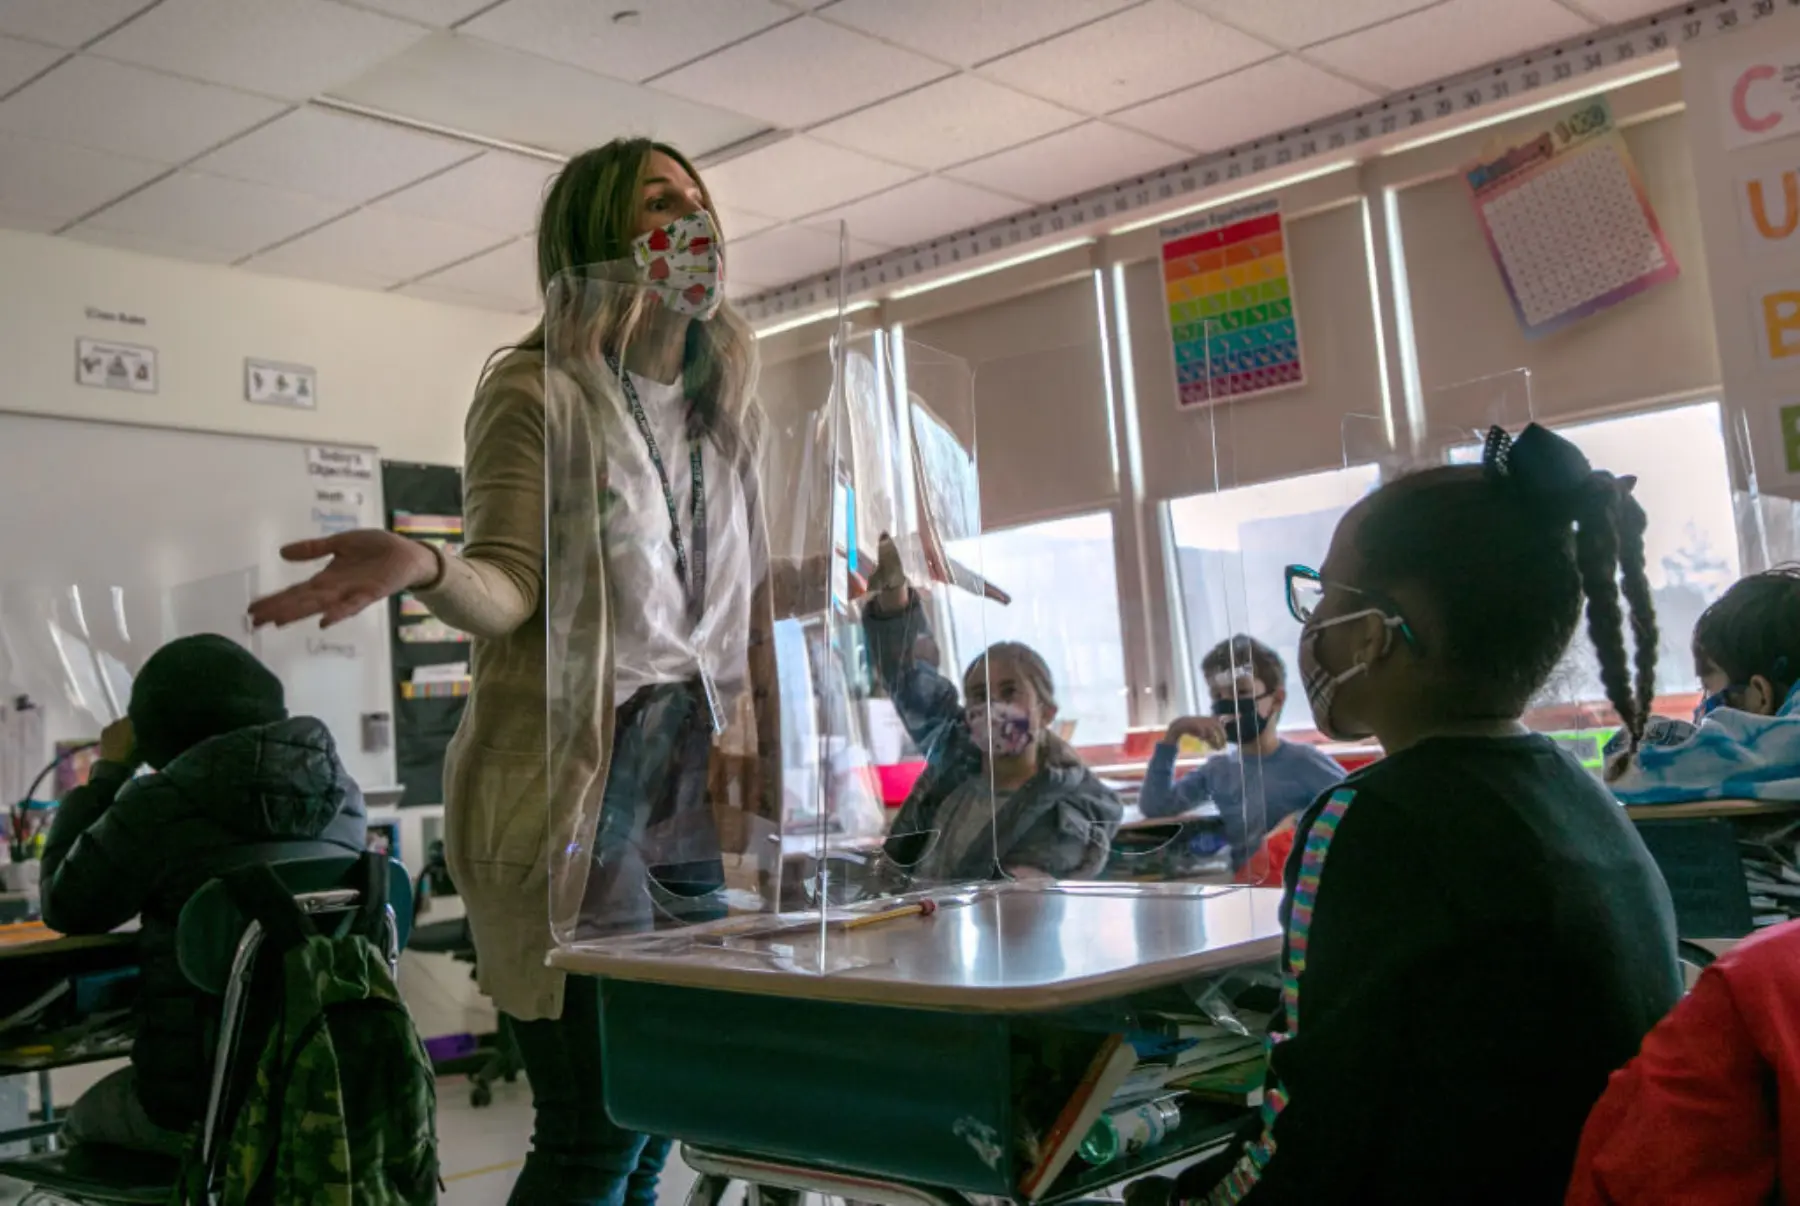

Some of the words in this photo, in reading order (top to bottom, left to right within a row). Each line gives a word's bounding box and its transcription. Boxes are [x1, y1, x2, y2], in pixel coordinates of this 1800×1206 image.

[1462, 90, 1481, 107] 30
[1492, 80, 1509, 98] 31
[1521, 71, 1541, 89] 32
[1552, 61, 1572, 80] 33
[1582, 52, 1603, 71] 34
[1616, 42, 1635, 61] 35
[1647, 32, 1668, 51] 36
[1682, 20, 1702, 40] 37
[1716, 9, 1738, 31] 38
[1752, 0, 1775, 19] 39
[1730, 65, 1783, 132] C
[1747, 171, 1799, 240] U
[1762, 290, 1800, 359] B
